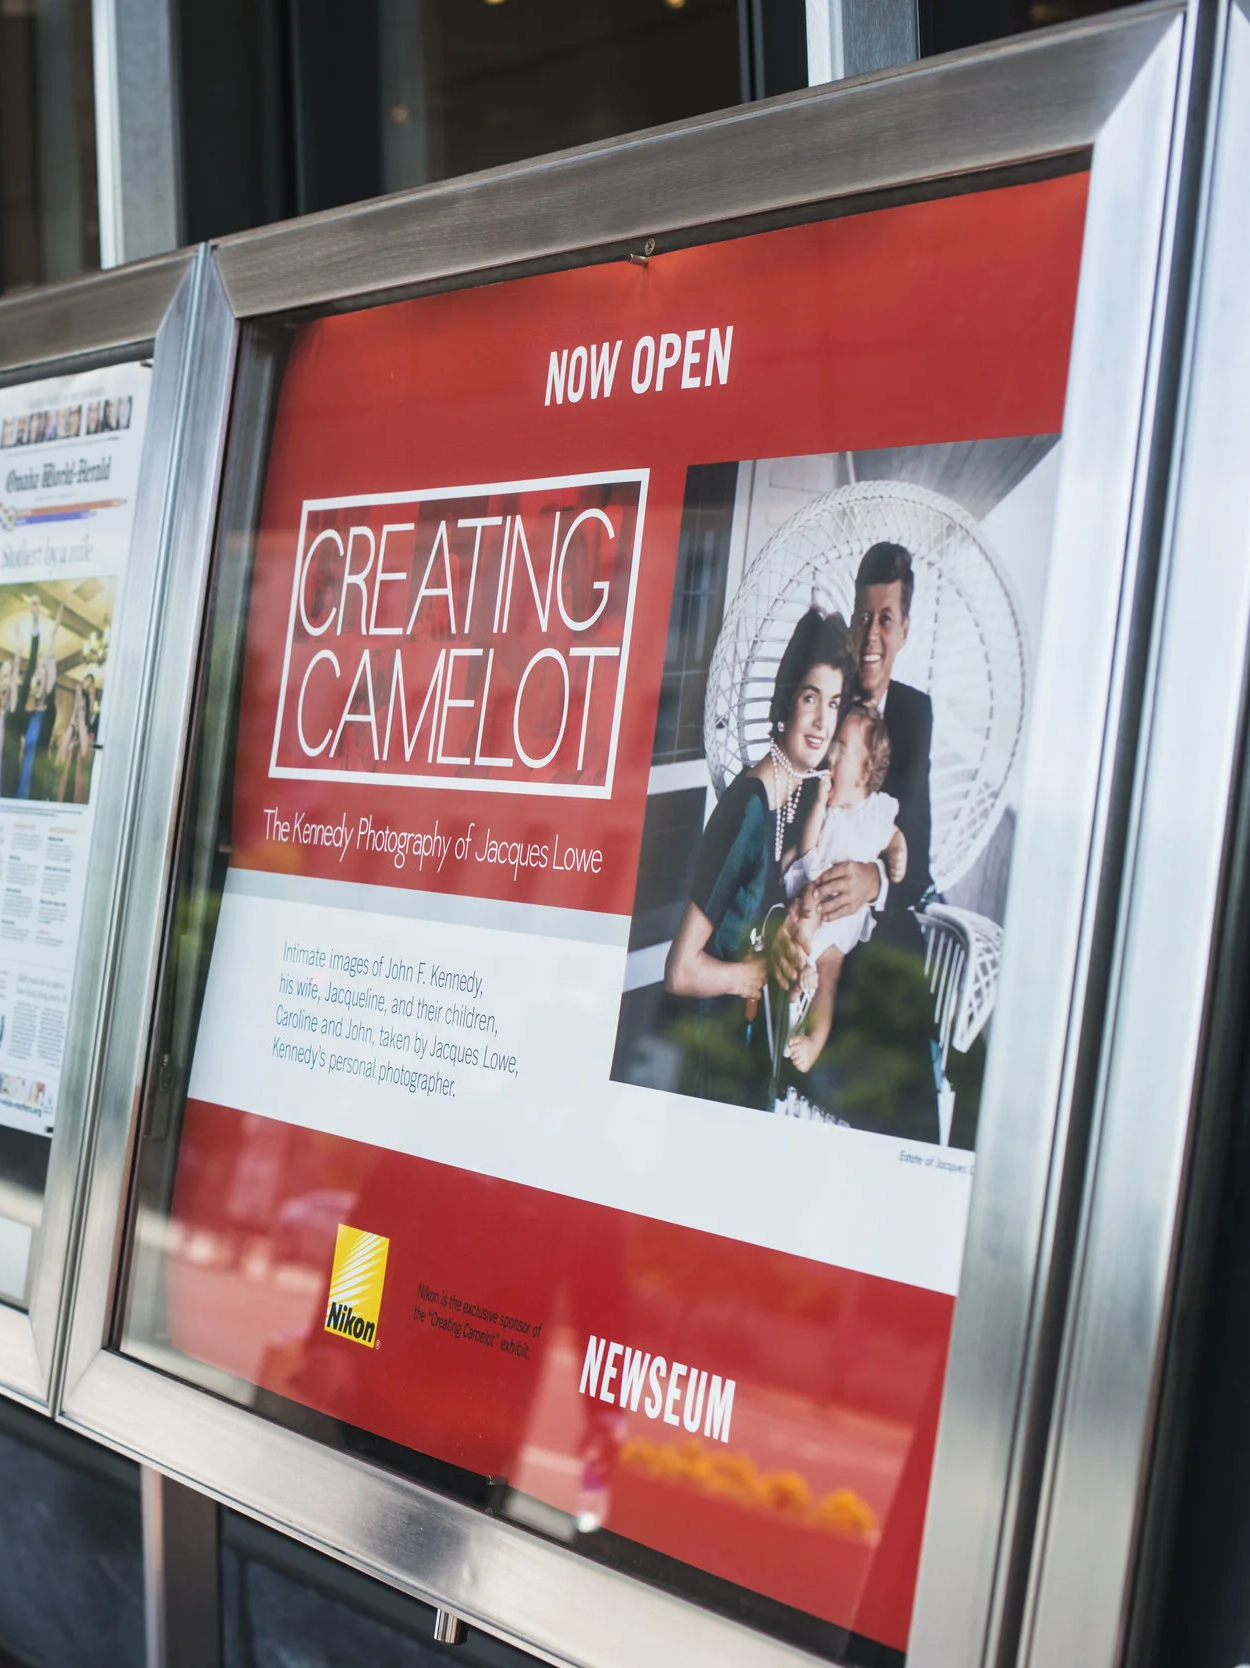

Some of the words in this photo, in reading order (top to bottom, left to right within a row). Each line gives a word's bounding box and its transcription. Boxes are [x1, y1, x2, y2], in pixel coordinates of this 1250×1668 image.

[545, 340, 622, 406] NOW
[631, 326, 734, 394] OPEN
[41, 455, 112, 488] World-Herald
[299, 508, 615, 636] CREATING
[297, 647, 620, 771] CAMELOT
[264, 807, 290, 842] The
[292, 812, 353, 863] Kennedy
[357, 815, 452, 873] Photography
[455, 823, 475, 860] of
[475, 829, 548, 881] Jacques
[553, 834, 603, 874] Lowe
[283, 941, 326, 968] Intimate
[329, 949, 369, 977] images
[372, 956, 385, 977] of
[385, 957, 413, 983] John
[417, 962, 426, 985] F.
[430, 965, 484, 999] Kennedy,
[279, 973, 294, 995] his
[297, 977, 321, 1001] wife,
[325, 982, 387, 1015] Jacqueline,
[391, 997, 413, 1017] and
[417, 1000, 443, 1023] their
[445, 1001, 498, 1037] children,
[272, 1036, 326, 1070] Kennedy's
[328, 1051, 375, 1079] personal
[378, 1061, 456, 1097] photographer.
[275, 1004, 318, 1033] Caroline
[321, 1017, 343, 1037] and
[345, 1018, 375, 1047] John,
[379, 1026, 410, 1052] taken
[414, 1032, 428, 1059] by
[430, 1035, 479, 1065] Jacques
[483, 1045, 519, 1078] Lowe,
[327, 1302, 375, 1343] Nikon
[413, 1307, 426, 1323] the
[500, 1338, 530, 1361] exhibit.
[417, 1284, 439, 1305] Nikon
[441, 1290, 448, 1307] is
[450, 1292, 462, 1312] the
[463, 1299, 498, 1324] exclusive
[499, 1313, 531, 1336] sponsor
[532, 1323, 543, 1338] of
[579, 1335, 736, 1444] NEWSEUM
